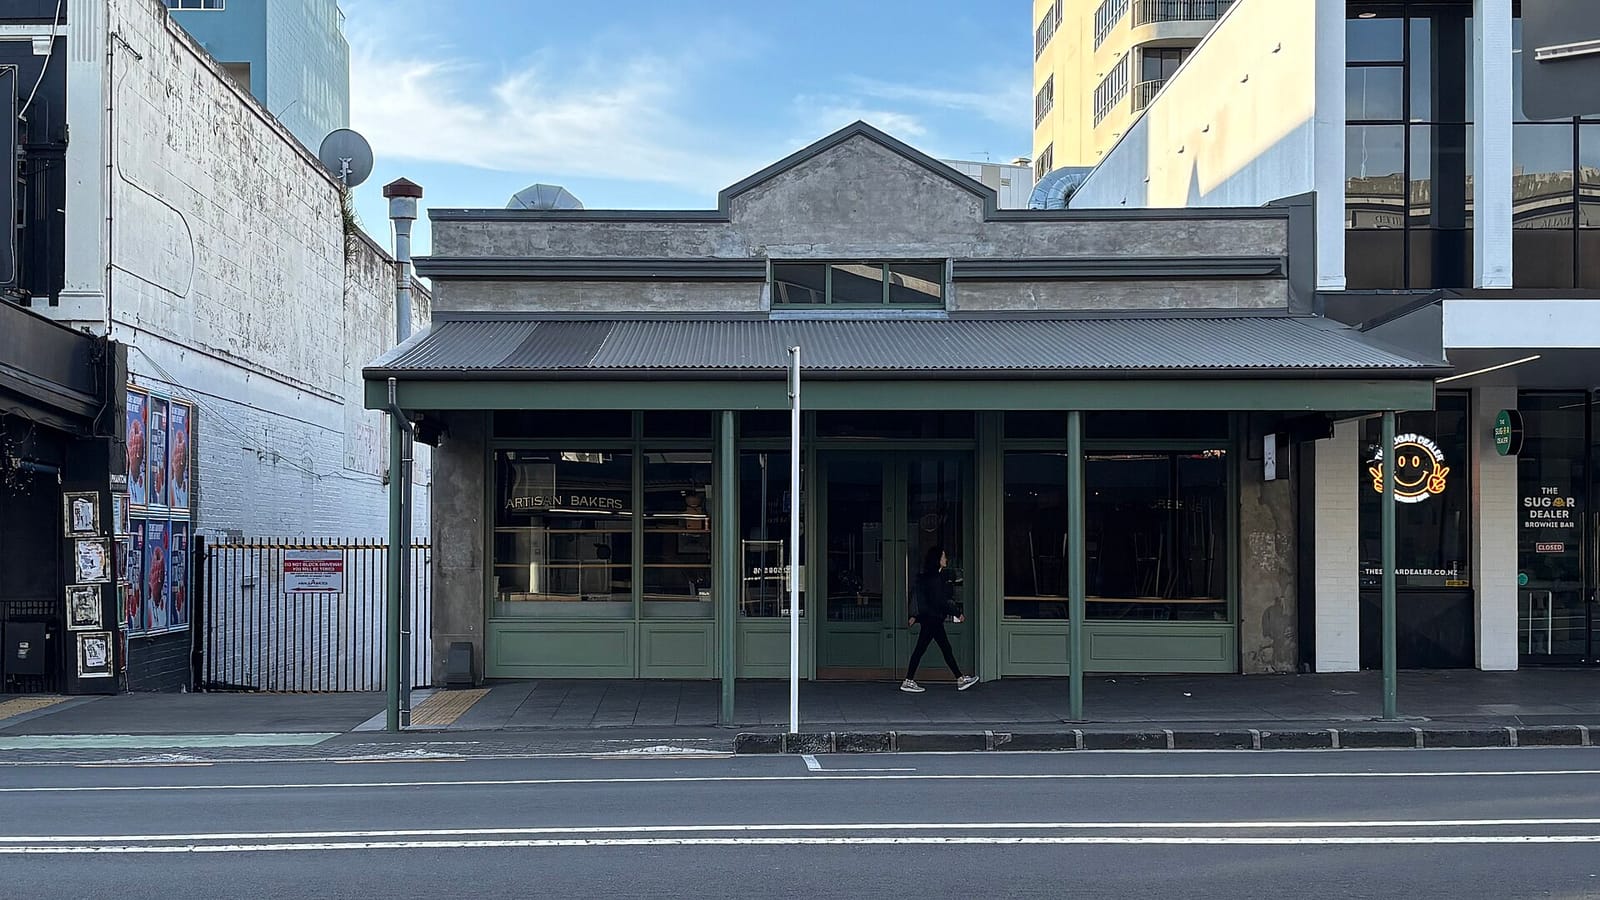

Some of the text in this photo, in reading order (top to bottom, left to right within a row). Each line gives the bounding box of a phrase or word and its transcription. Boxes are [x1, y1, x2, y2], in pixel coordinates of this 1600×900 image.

[1393, 433, 1417, 445] UGAR
[1417, 436, 1445, 462] DEALER
[1541, 487, 1558, 495] THE
[505, 495, 624, 509] ARTISAN BAKERS
[1529, 510, 1569, 519] DEALER
[1364, 568, 1459, 576] THESARDEALER.CO.NZ
